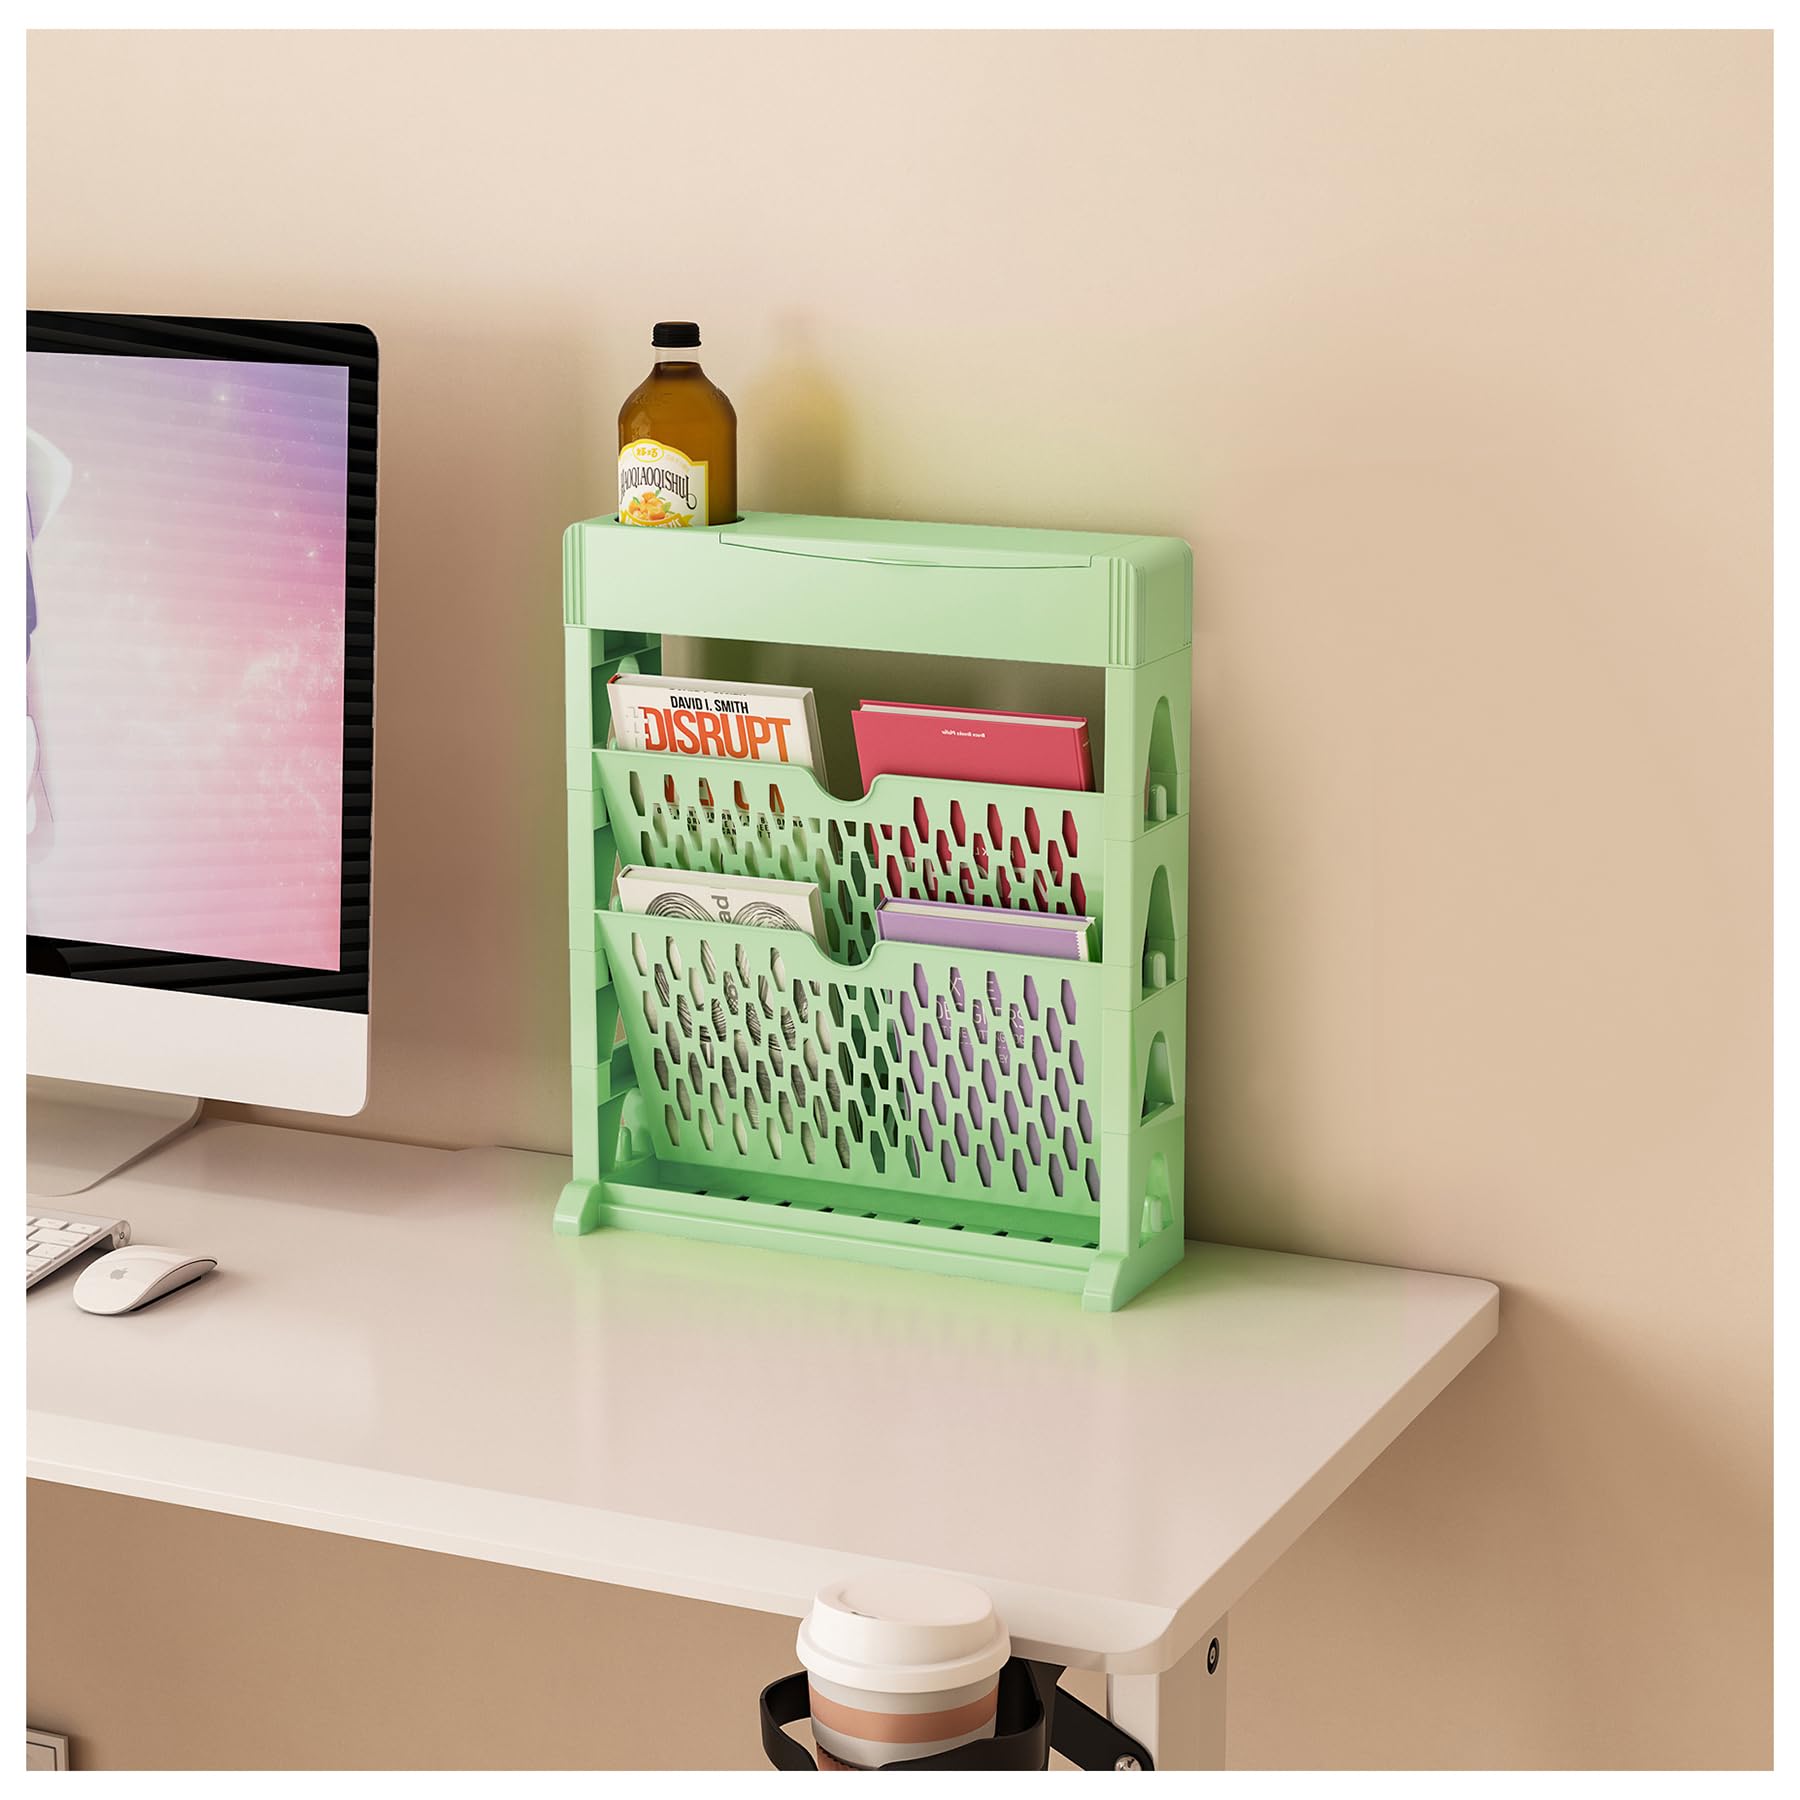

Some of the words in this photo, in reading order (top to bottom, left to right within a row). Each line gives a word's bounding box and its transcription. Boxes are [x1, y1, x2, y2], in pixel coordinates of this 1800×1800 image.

[670, 696, 703, 710] DAVID
[704, 698, 713, 711] I.
[714, 699, 749, 714] SMITH
